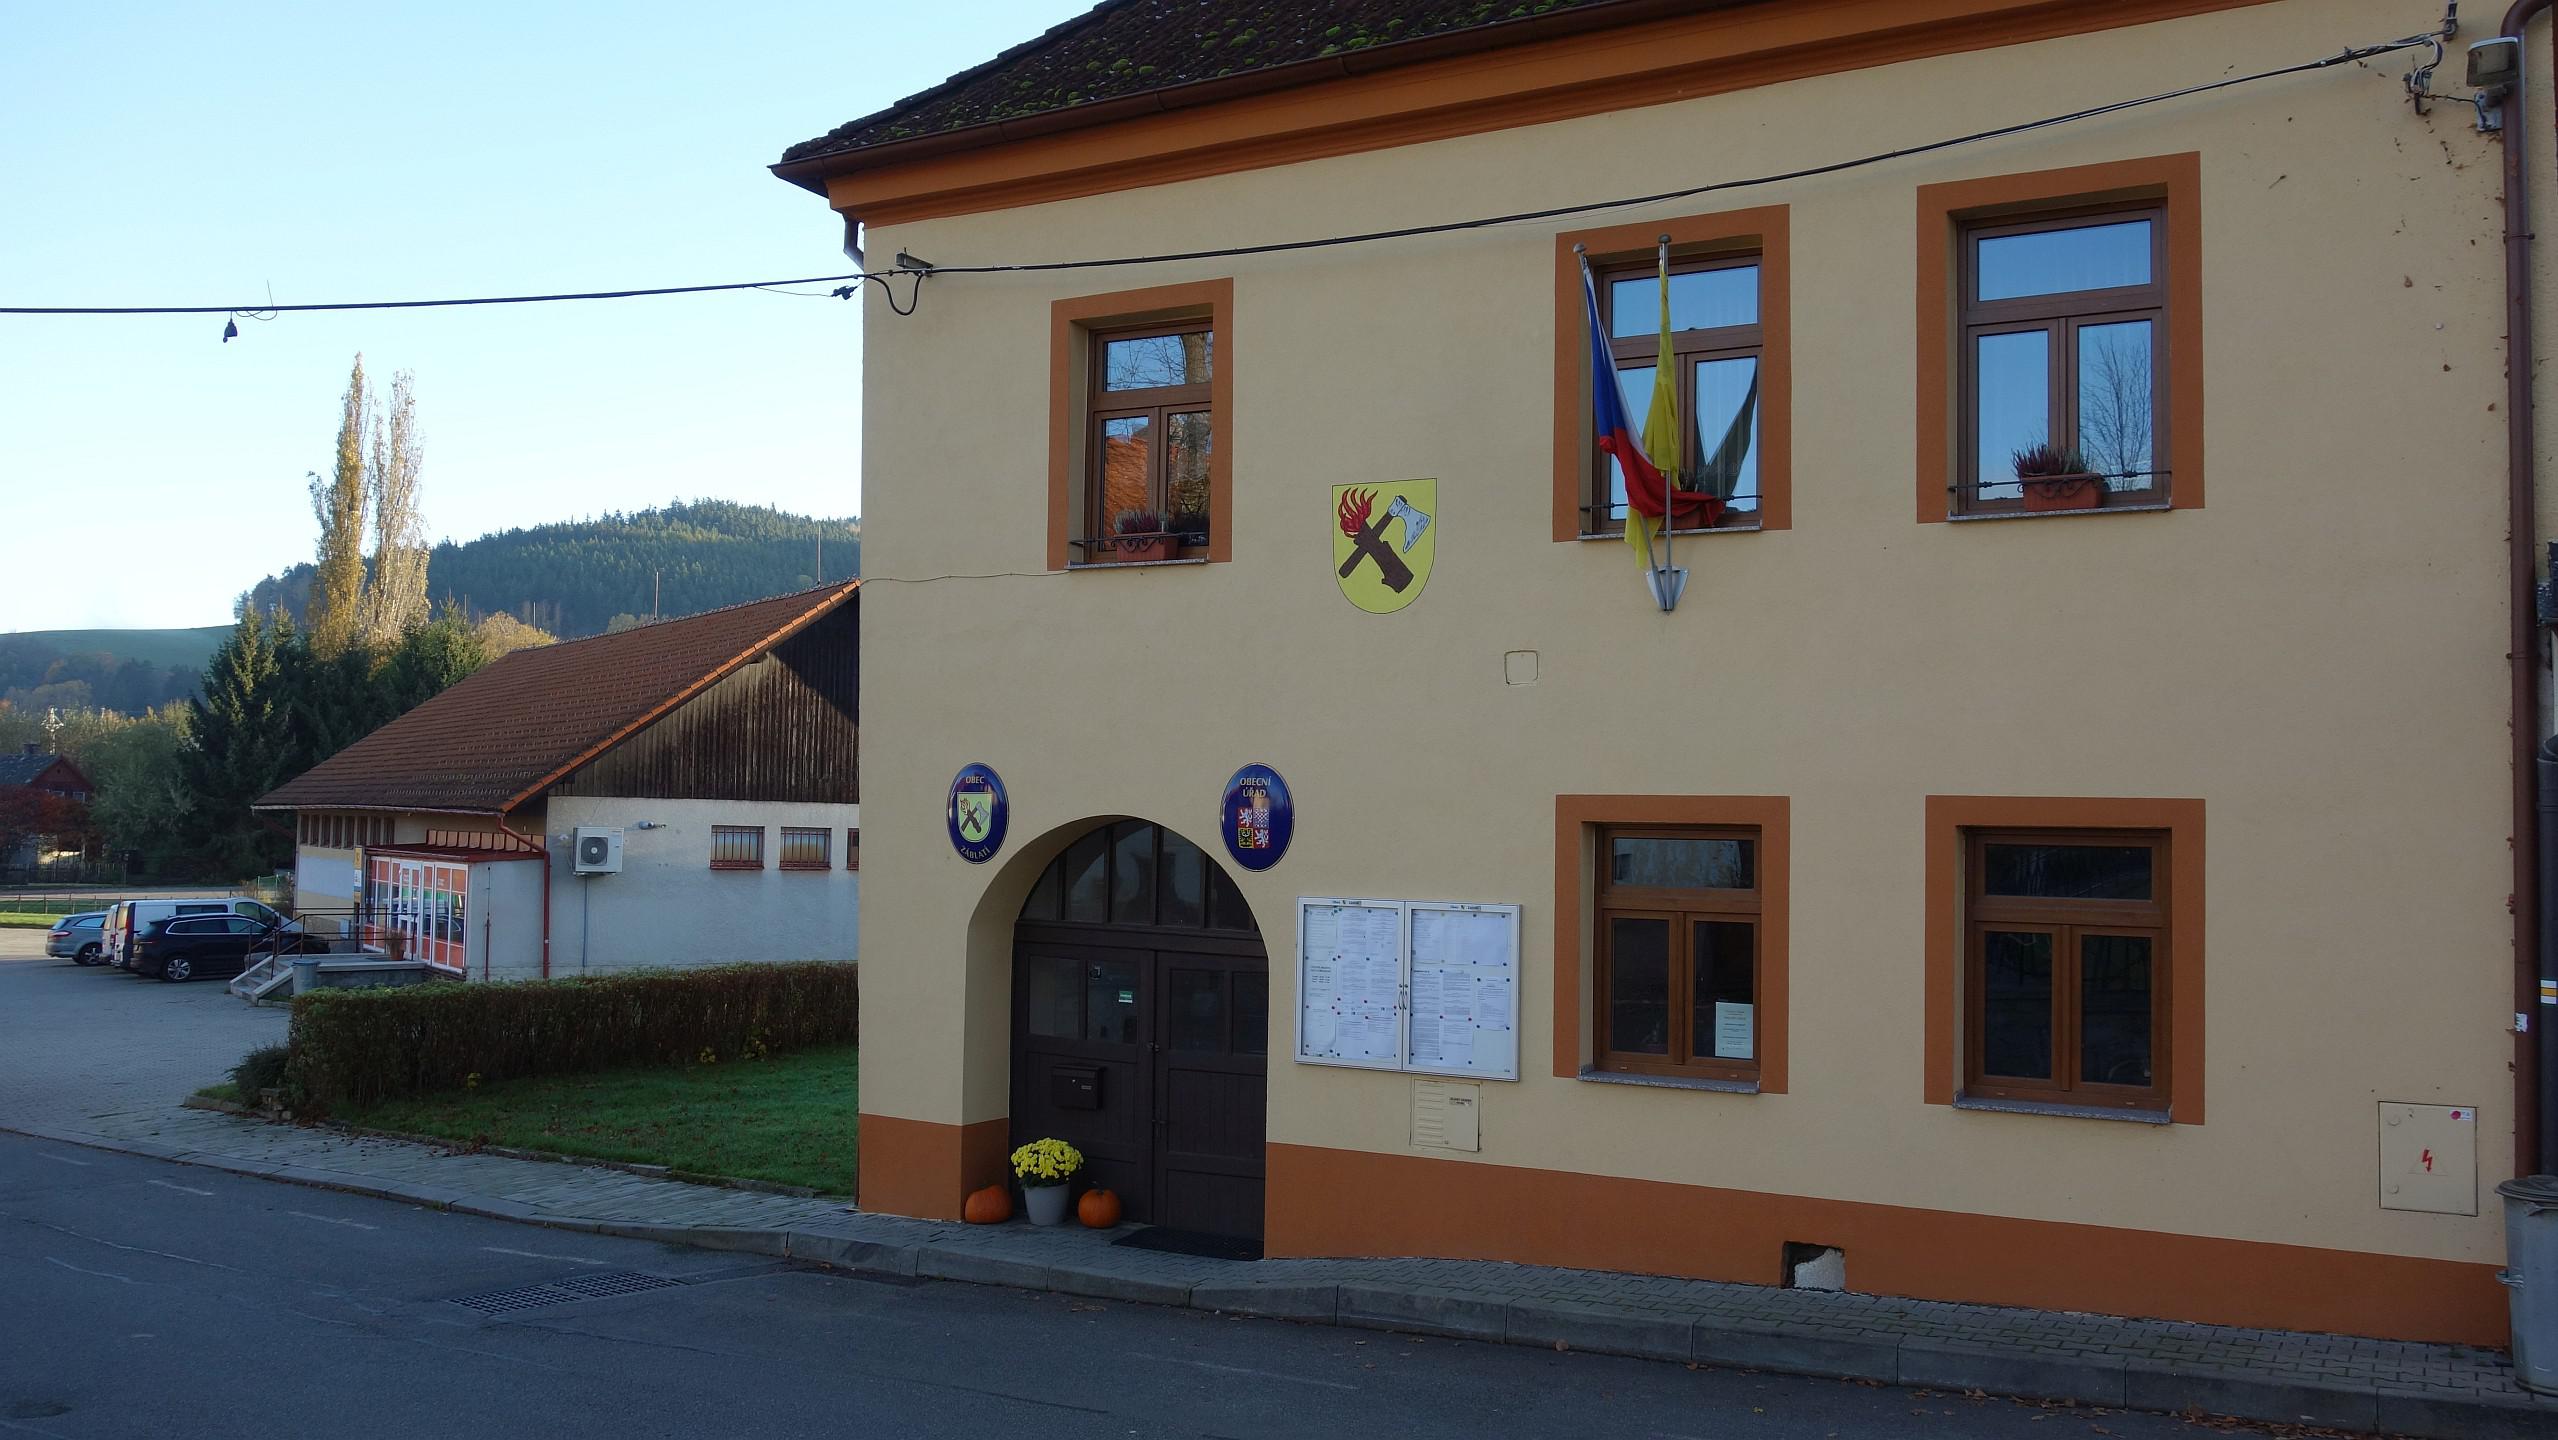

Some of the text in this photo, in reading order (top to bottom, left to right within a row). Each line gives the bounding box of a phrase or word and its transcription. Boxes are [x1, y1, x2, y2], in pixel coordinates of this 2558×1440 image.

[965, 776, 985, 785] OBEC
[1239, 775, 1272, 786] OBECNÍ
[1242, 786, 1267, 798] ÚŘAD
[960, 845, 991, 859] ZÁBLATÍ
